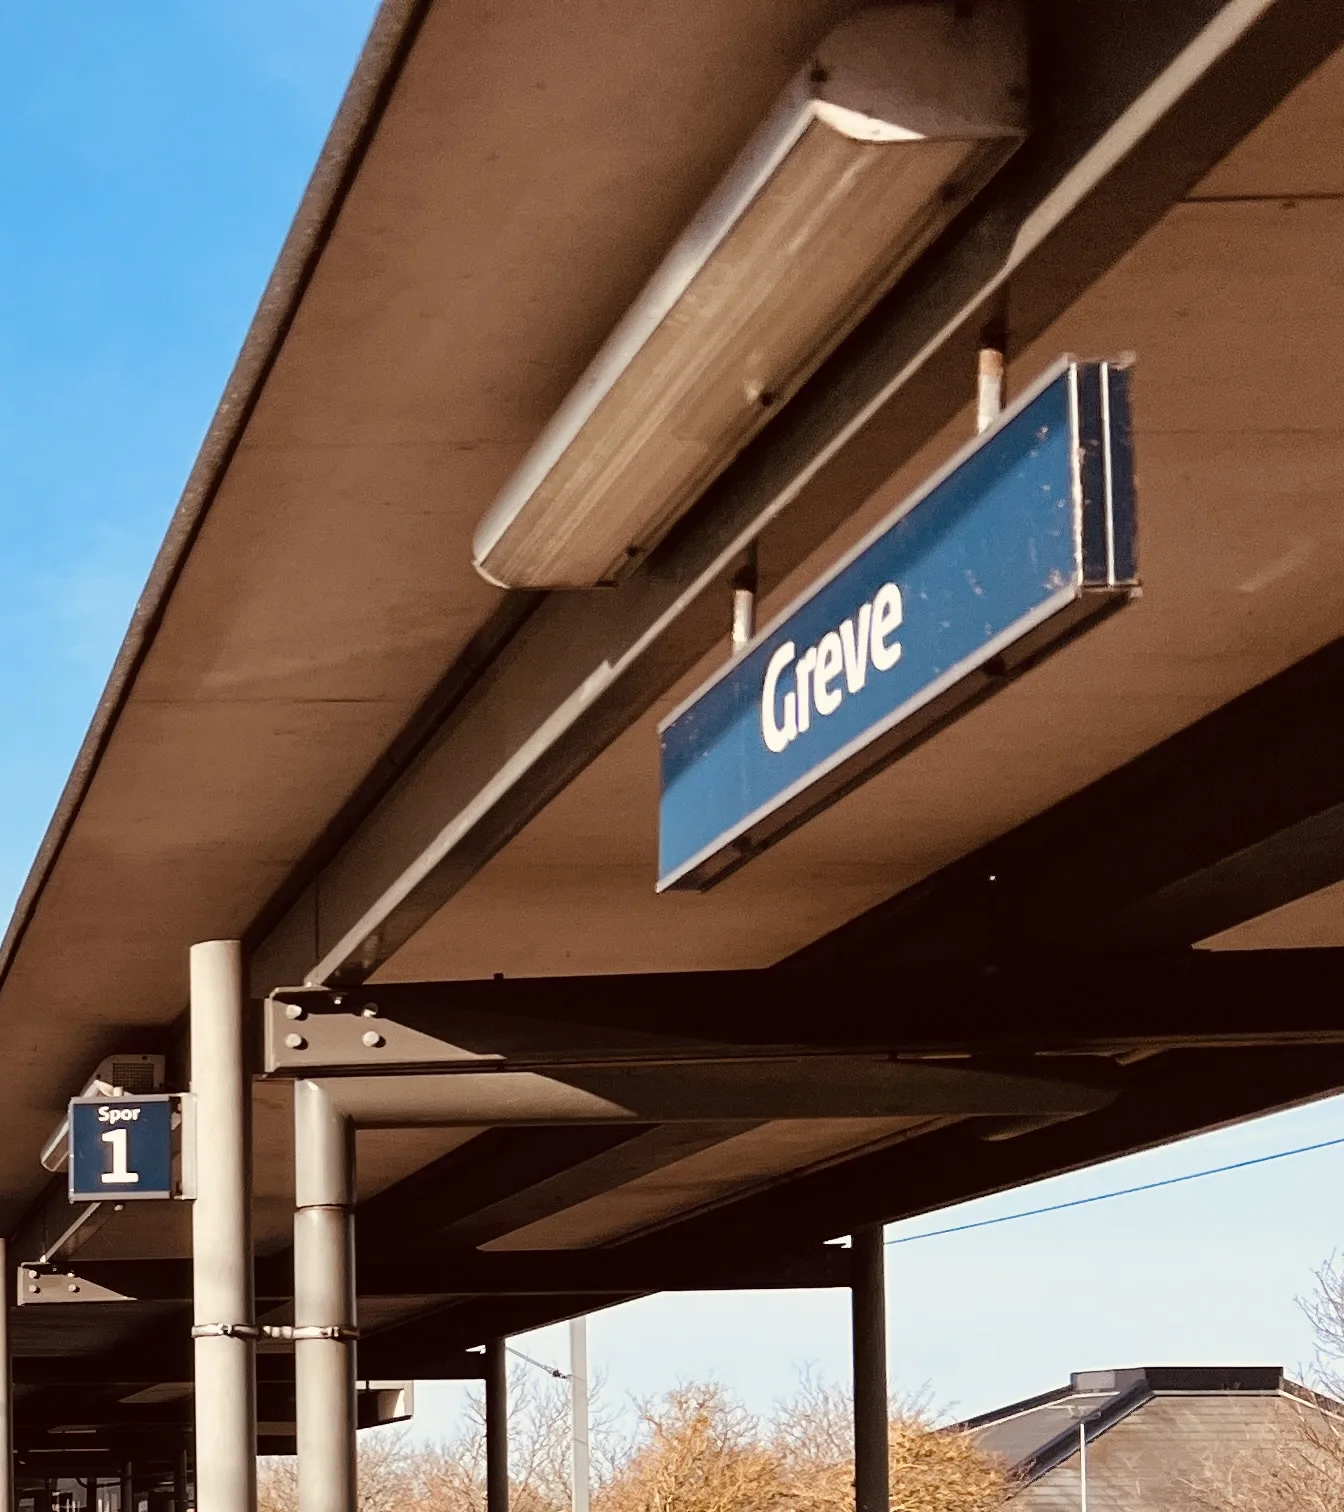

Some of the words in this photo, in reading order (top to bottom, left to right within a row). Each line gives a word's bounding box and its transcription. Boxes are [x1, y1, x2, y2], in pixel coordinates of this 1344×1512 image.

[762, 582, 903, 752] Greve
[98, 1106, 141, 1125] Spor
[101, 1128, 139, 1184] 1
